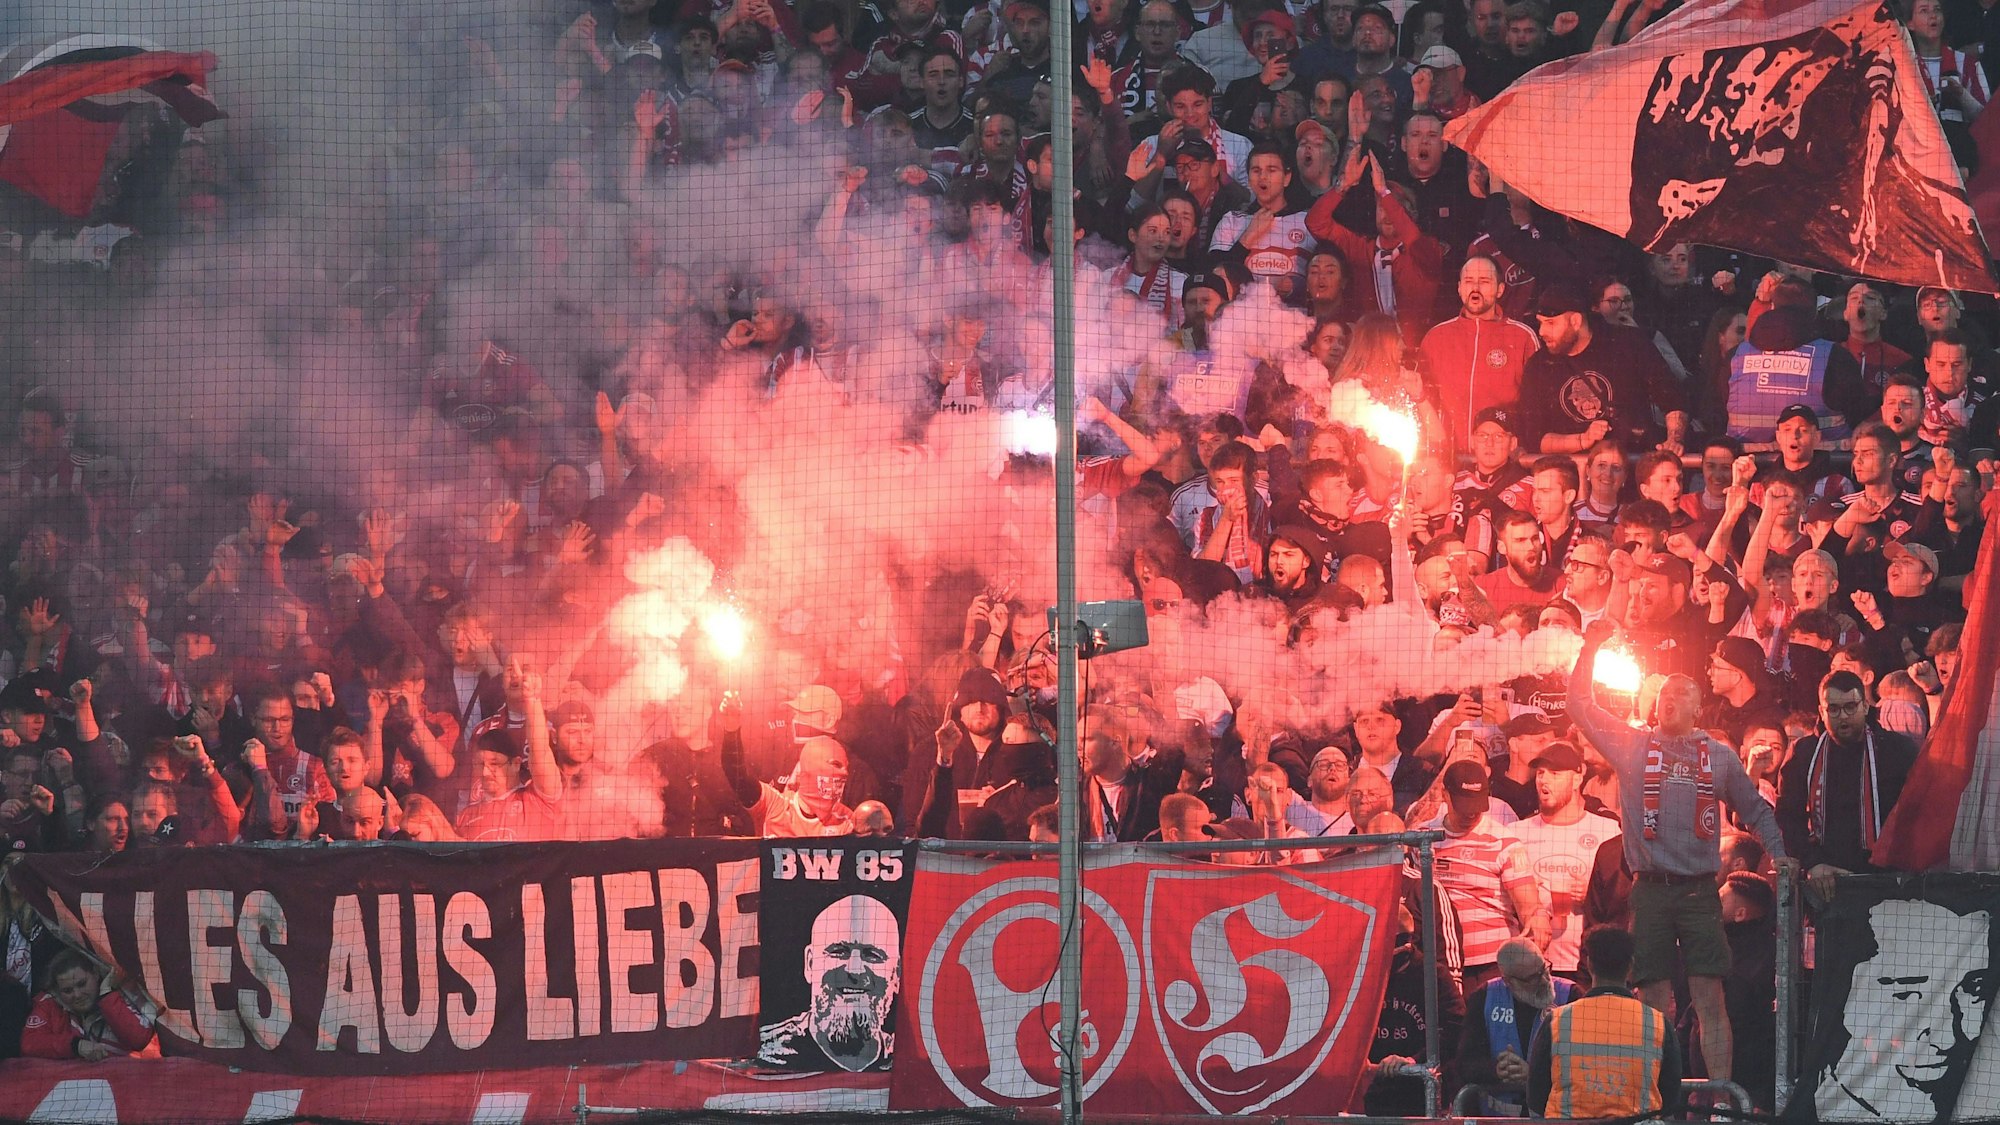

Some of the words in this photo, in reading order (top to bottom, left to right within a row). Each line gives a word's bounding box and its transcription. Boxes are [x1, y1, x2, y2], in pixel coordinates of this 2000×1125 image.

[1250, 259, 1289, 270] Henkel
[1745, 358, 1807, 374] seCurity
[1759, 372, 1770, 385] S
[772, 848, 844, 881] BW
[856, 849, 903, 882] 85
[1538, 861, 1582, 874] Henkel
[47, 885, 292, 1050] LES
[316, 891, 497, 1054] AUS
[522, 859, 760, 1040] LIEBE
[1490, 1006, 1514, 1024] 678
